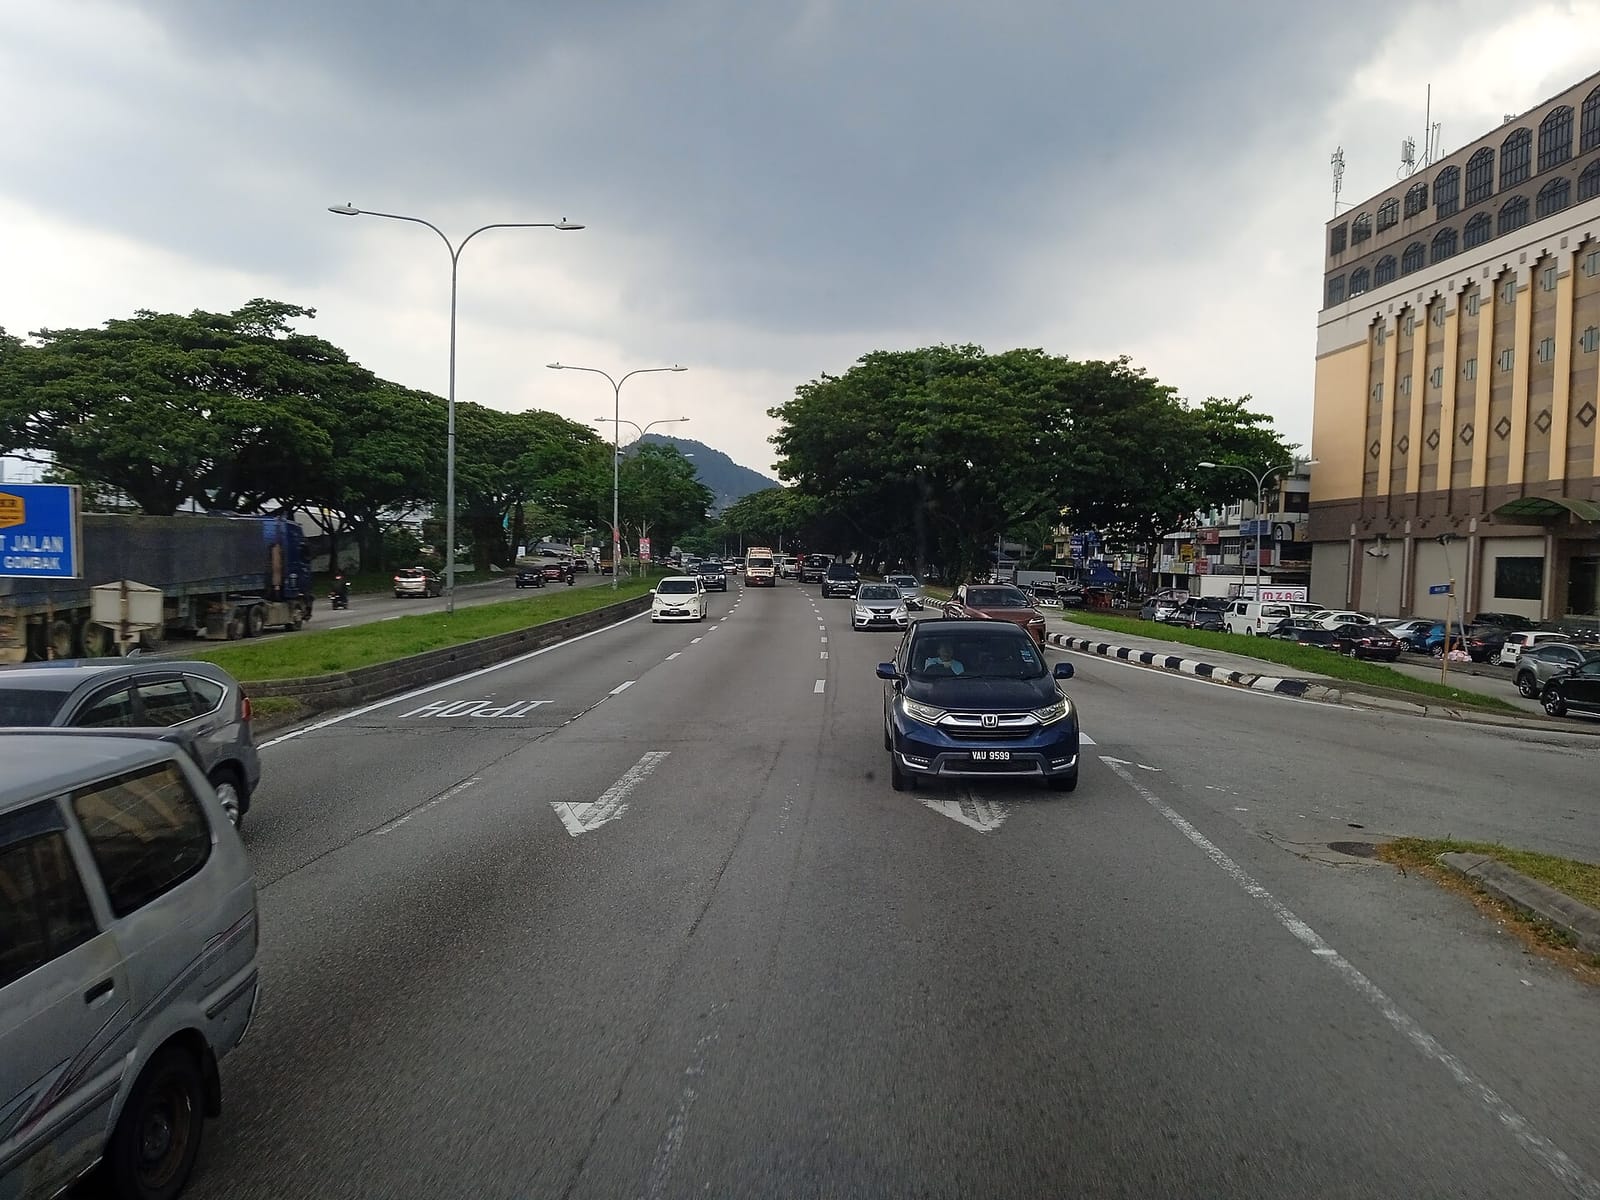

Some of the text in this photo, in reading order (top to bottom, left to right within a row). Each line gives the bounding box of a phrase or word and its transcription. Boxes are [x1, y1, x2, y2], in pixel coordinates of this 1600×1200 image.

[10, 535, 64, 553] JALAN
[3, 556, 61, 570] GOMBAK
[398, 700, 555, 718] IPOH
[972, 751, 1010, 760] VAU 9599
